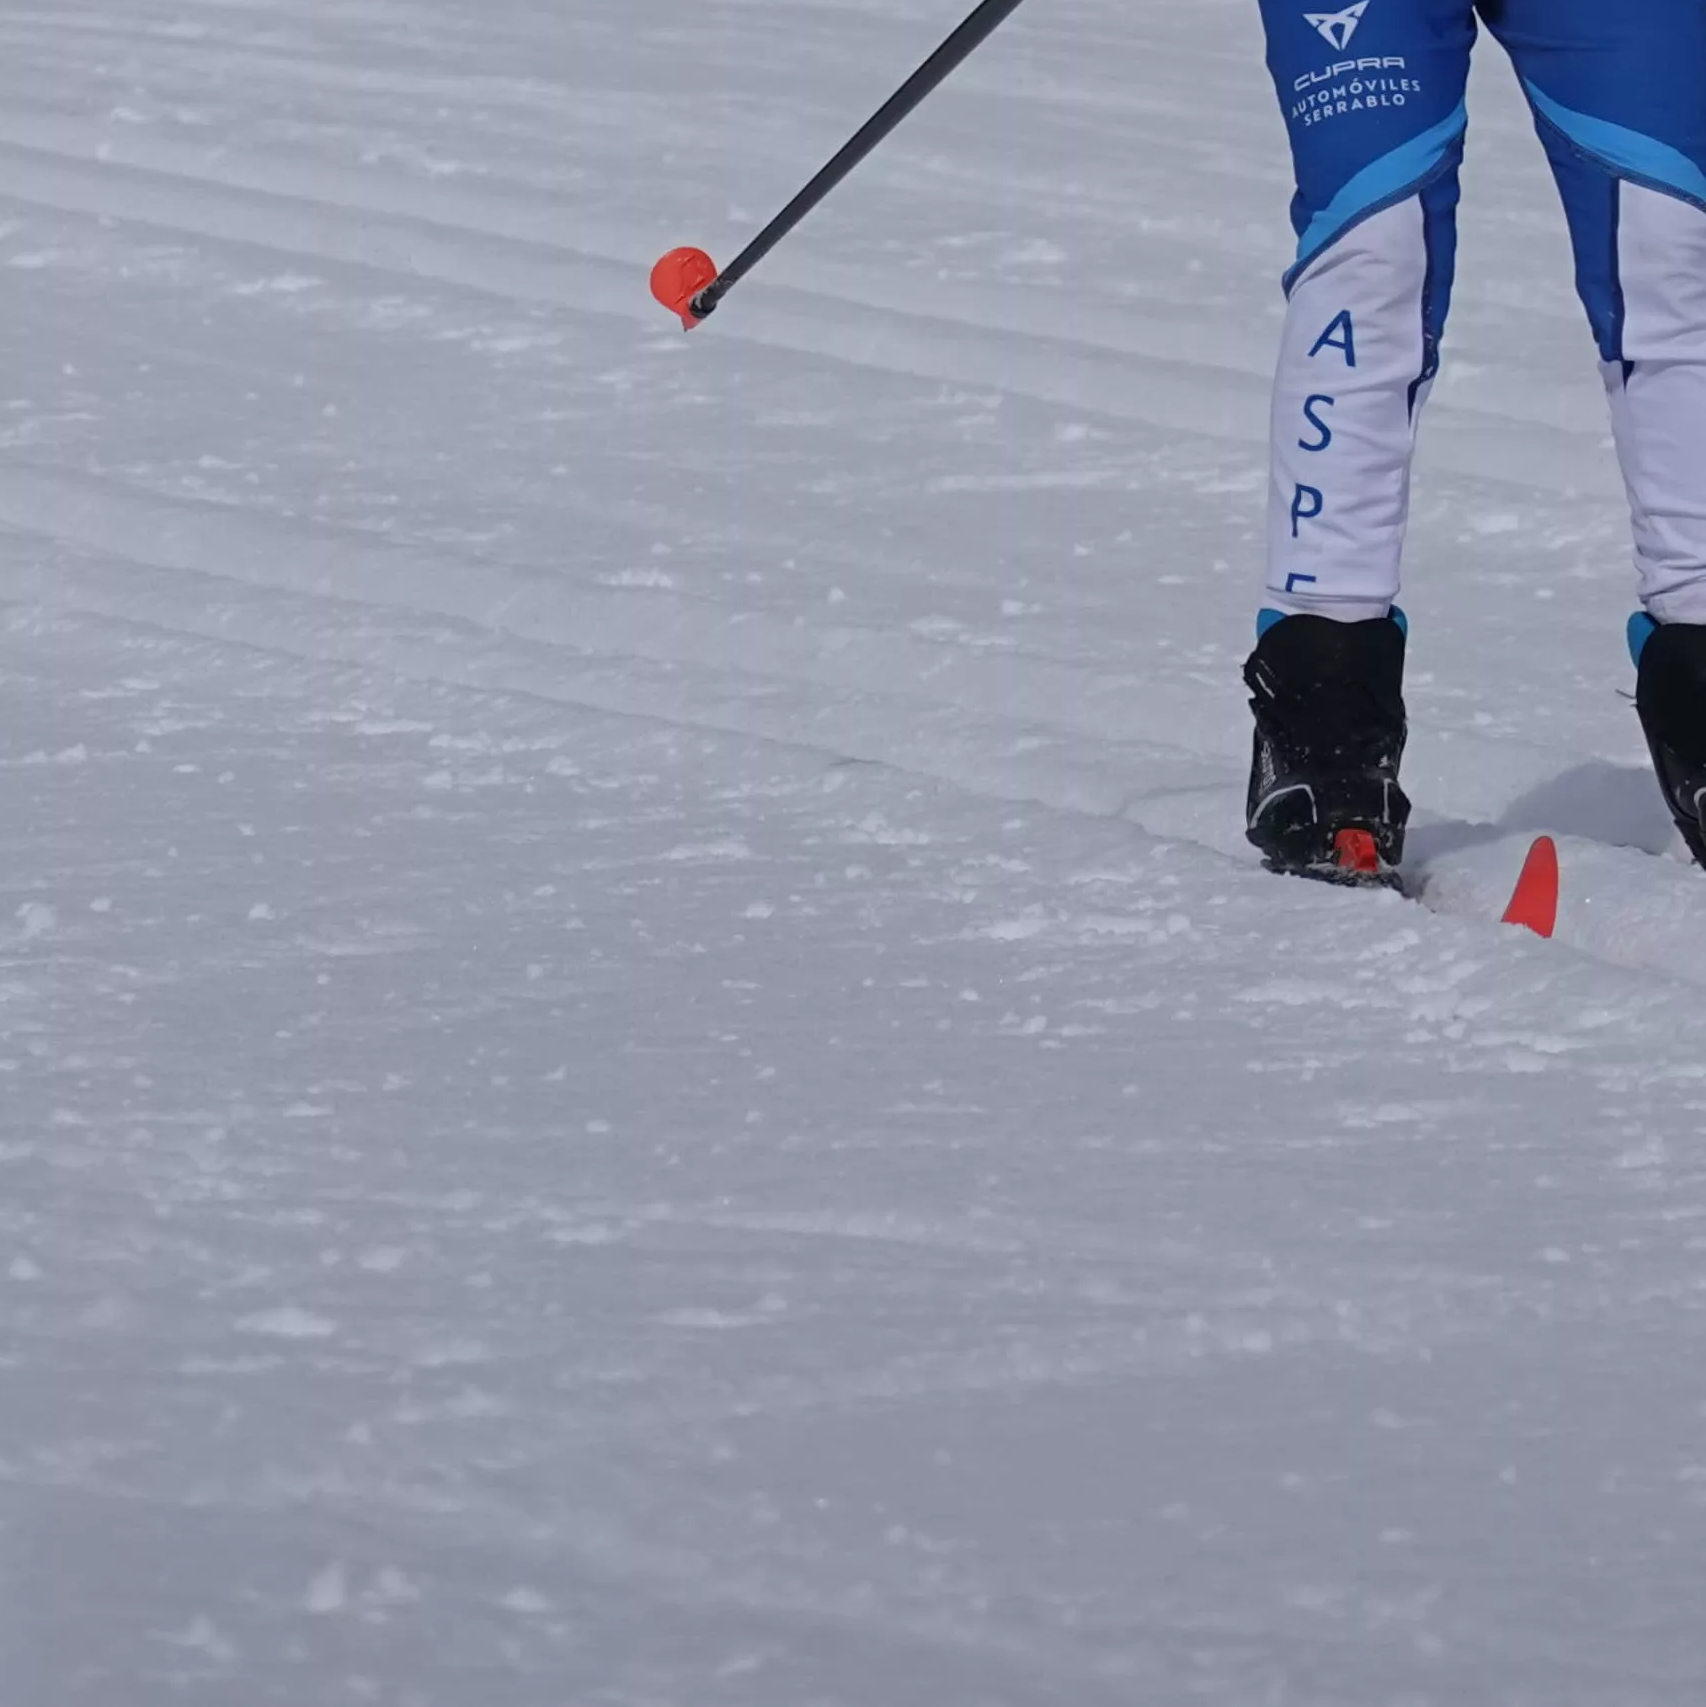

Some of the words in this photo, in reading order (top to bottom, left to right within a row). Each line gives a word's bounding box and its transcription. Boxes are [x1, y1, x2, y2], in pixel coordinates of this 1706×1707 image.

[1294, 56, 1406, 92] CUPRA
[1292, 78, 1421, 119] AUTOMÓVILES
[1304, 94, 1406, 127] SERRABLO
